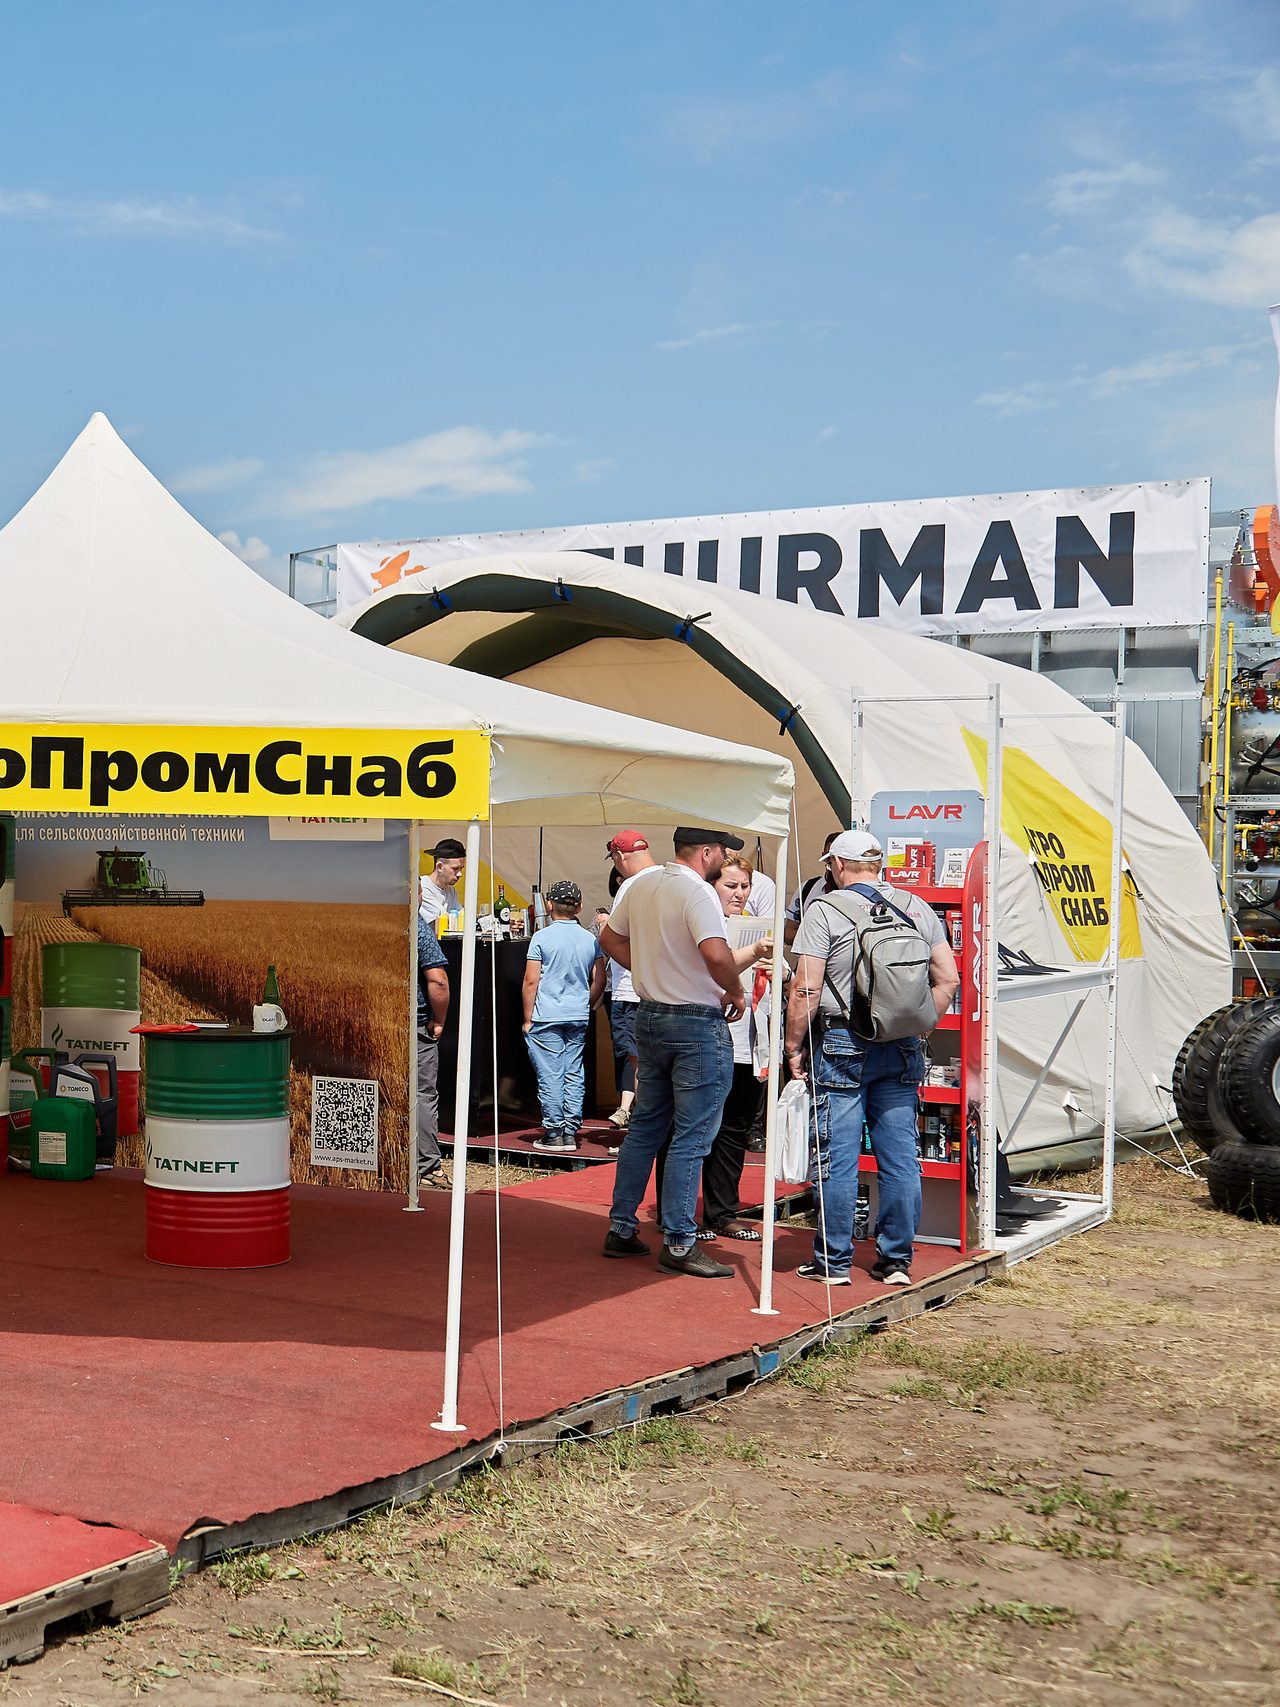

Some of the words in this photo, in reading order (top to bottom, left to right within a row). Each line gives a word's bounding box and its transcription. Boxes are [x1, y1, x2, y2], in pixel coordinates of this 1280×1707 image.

[889, 805, 963, 820] LAVR
[39, 824, 187, 841] сельскохозяйственной
[191, 828, 245, 841] техники
[1060, 897, 1110, 927] СНАБ
[972, 902, 982, 1022] LAVR
[65, 1039, 130, 1051] TATNEFT
[938, 1123, 946, 1159] LAVR
[153, 1156, 240, 1174] TATNEFT
[314, 1155, 375, 1166] www.aps-market.ru
